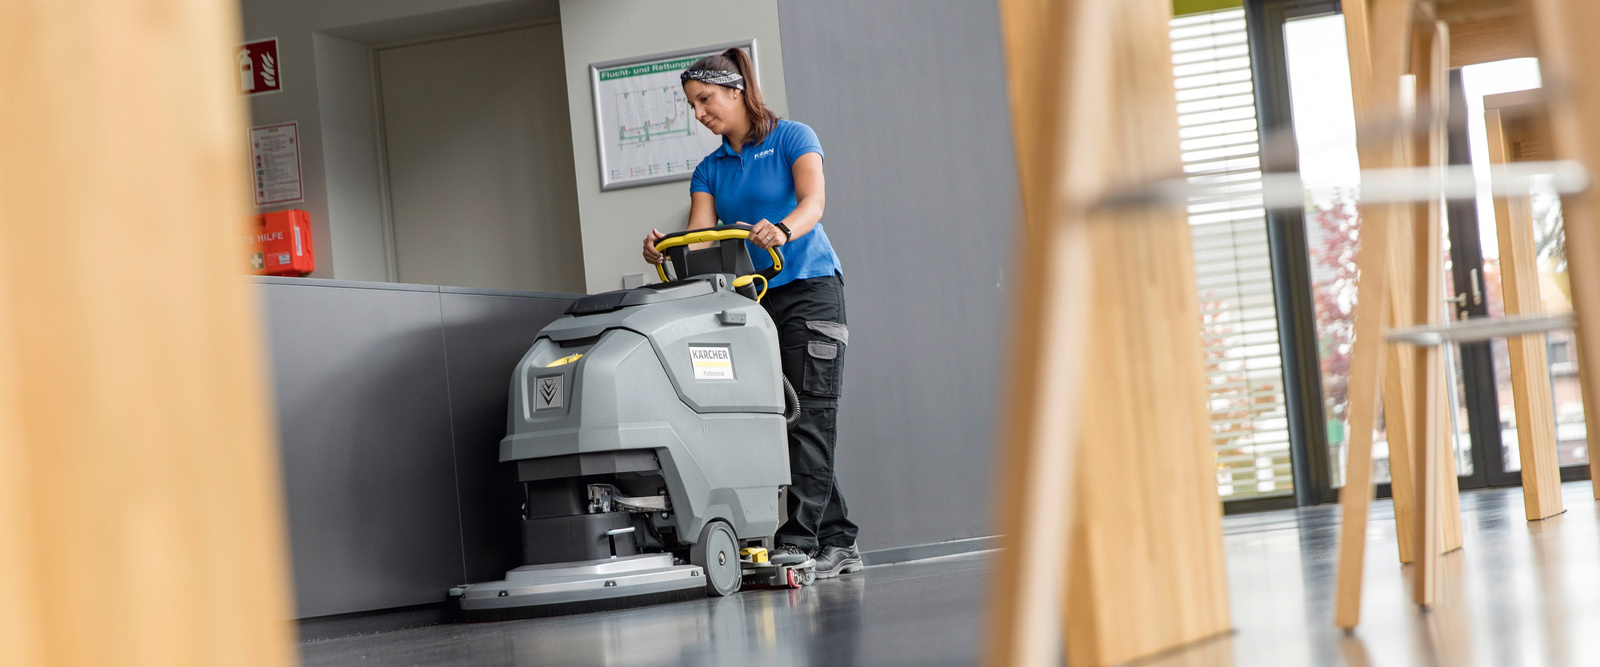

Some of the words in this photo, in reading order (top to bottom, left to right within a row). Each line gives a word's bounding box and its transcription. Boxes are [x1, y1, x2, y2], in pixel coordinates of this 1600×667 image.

[601, 69, 631, 79] Flucht-
[633, 65, 650, 75] und
[257, 231, 284, 243] HILFE
